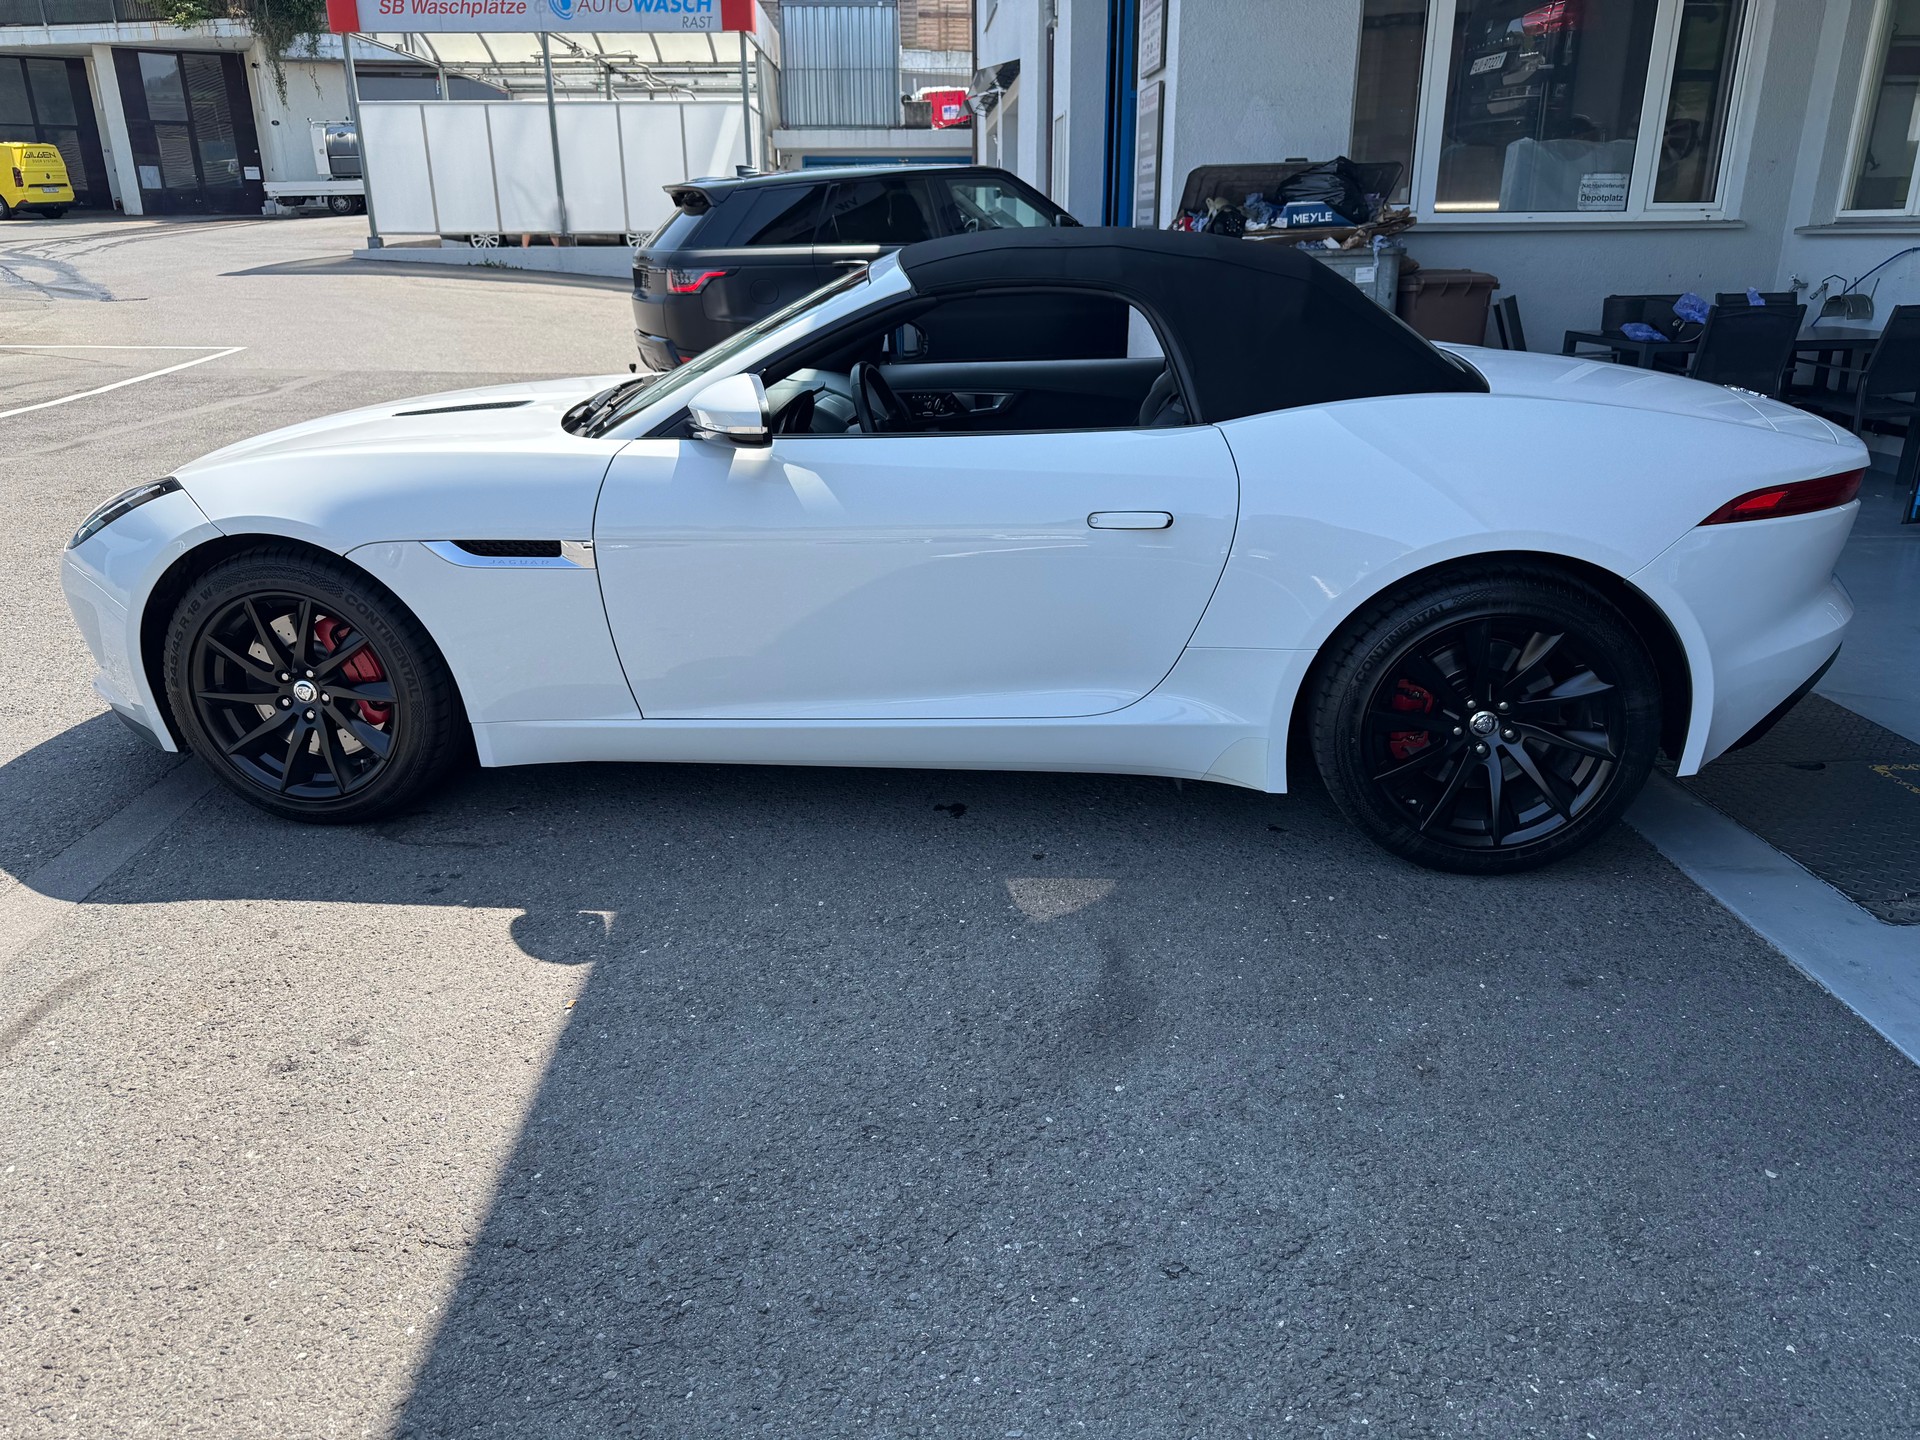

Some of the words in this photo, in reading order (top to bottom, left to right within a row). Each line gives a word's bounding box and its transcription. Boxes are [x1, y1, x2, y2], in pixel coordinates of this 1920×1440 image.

[379, 0, 405, 15] SB
[411, 0, 527, 18] Waschplätze
[682, 16, 713, 29] RAST
[24, 151, 57, 159] GILGEN
[1580, 193, 1624, 203] Depotplatz
[1292, 211, 1333, 224] MEYLE
[187, 599, 202, 616] 18
[344, 593, 420, 699] CONTINENTAL
[1354, 603, 1447, 683] CONTINENTAL
